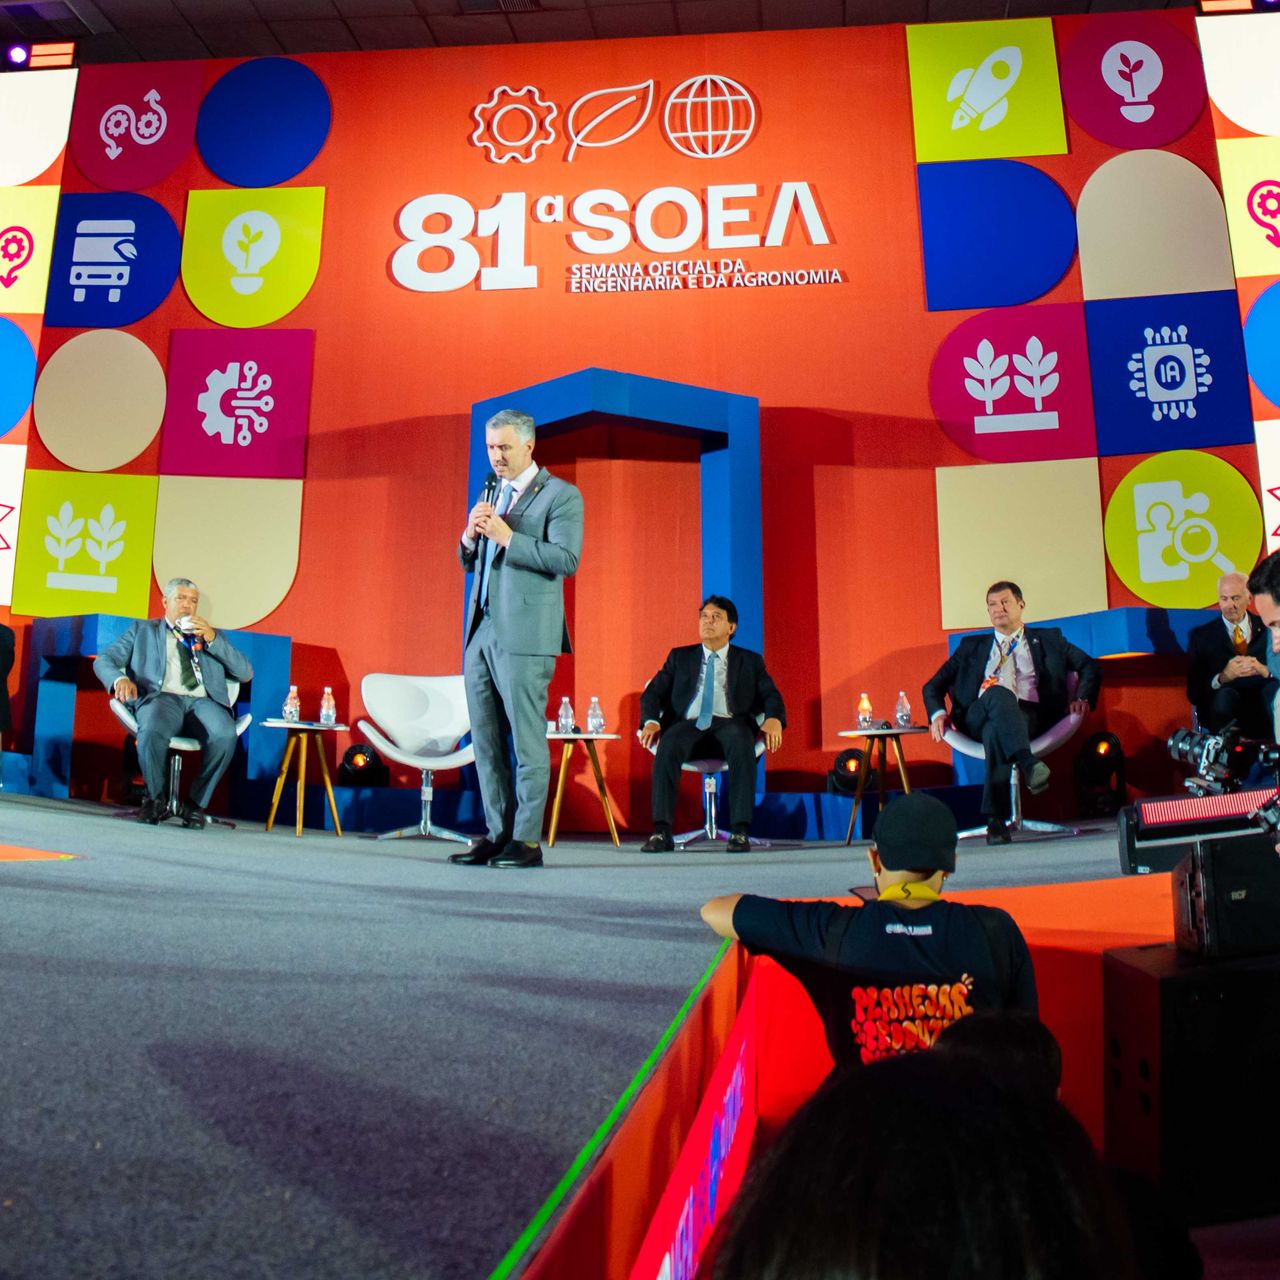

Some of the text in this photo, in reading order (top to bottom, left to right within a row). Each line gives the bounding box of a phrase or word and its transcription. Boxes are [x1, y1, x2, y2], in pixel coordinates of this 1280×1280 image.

[570, 181, 830, 254] SOEA
[571, 257, 746, 279] SEMANA OFICIAL DA
[571, 268, 842, 293] ENGENHARIA E DA AGRONOMIA
[1160, 361, 1180, 383] IA
[851, 982, 974, 1023] PLANEJAR
